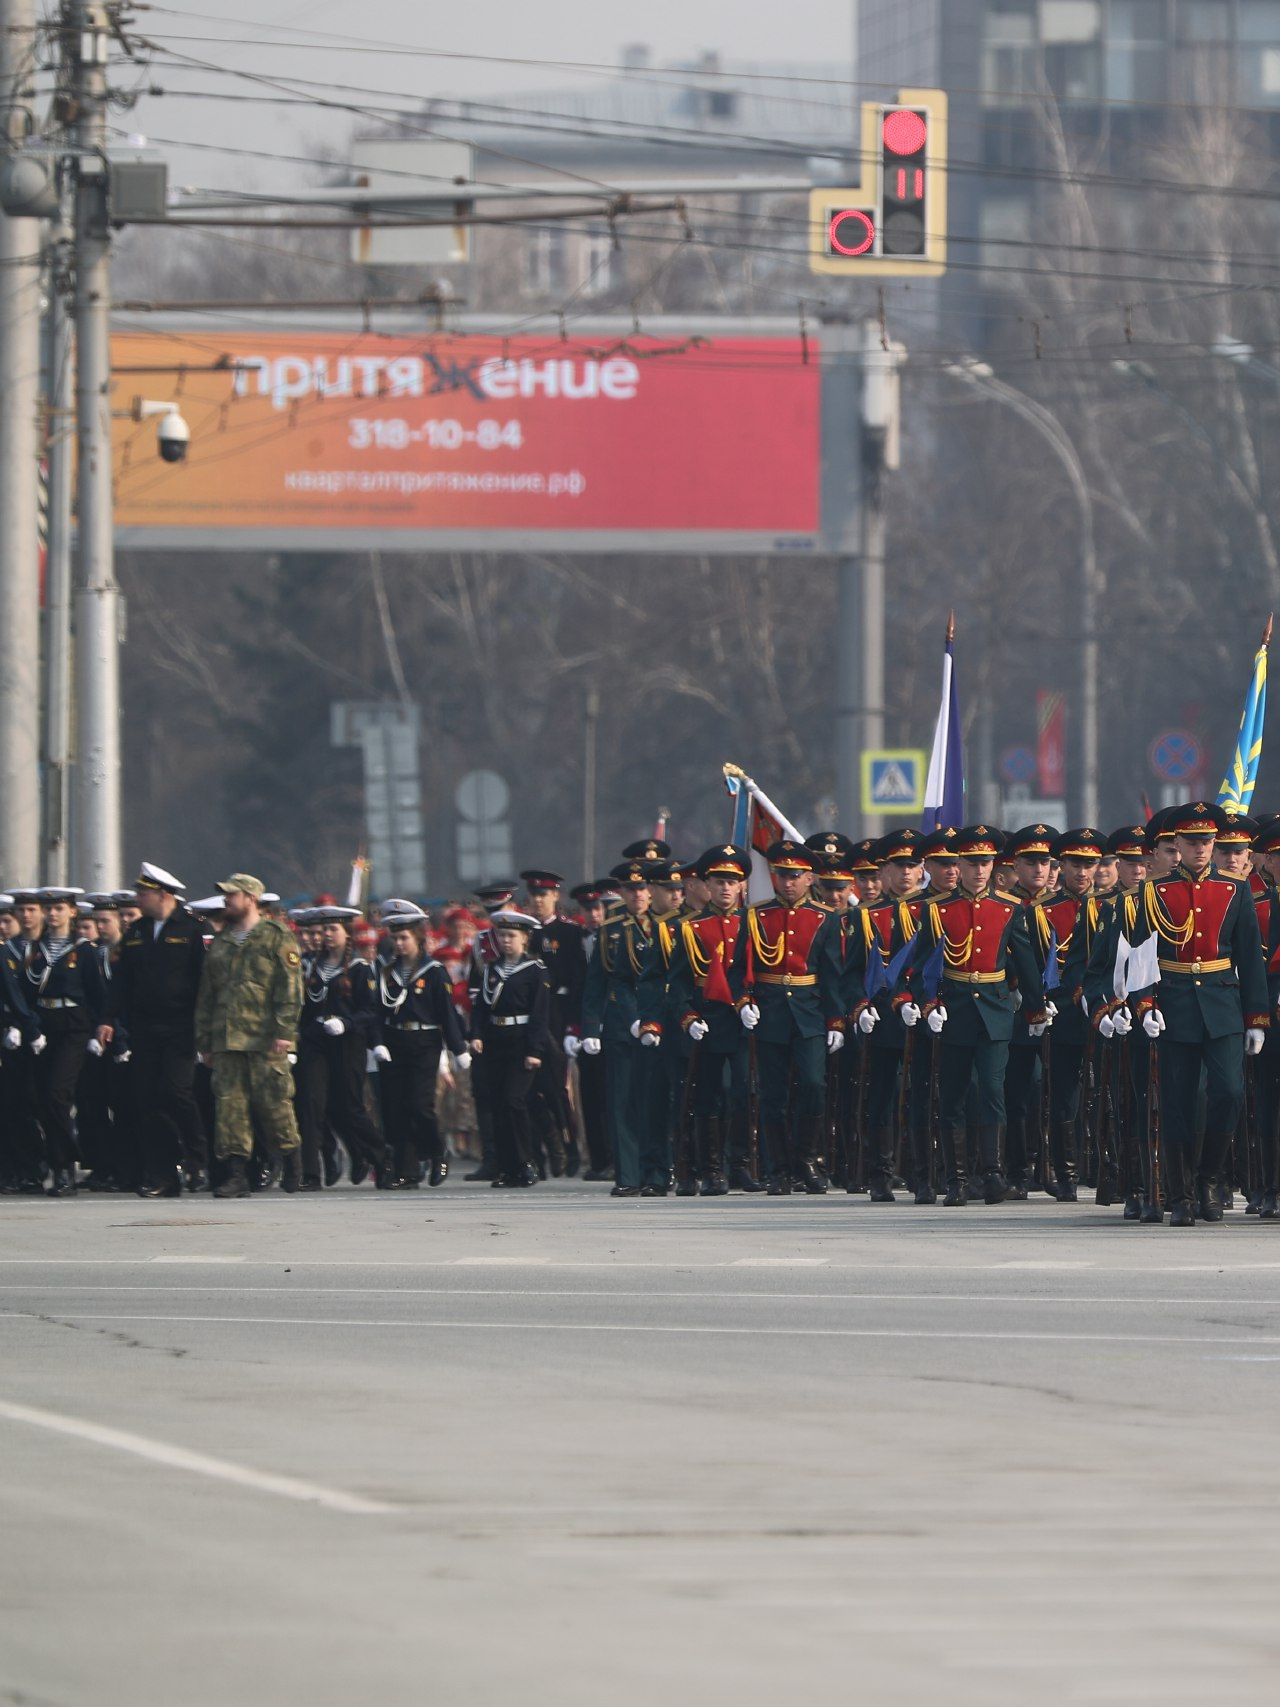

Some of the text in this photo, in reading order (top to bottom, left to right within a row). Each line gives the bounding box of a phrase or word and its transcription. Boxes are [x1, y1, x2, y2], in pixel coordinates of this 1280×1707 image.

[232, 353, 639, 410] притяжение
[348, 419, 523, 449] 318-10-84
[285, 469, 586, 497] кварталпритяжение.рф
